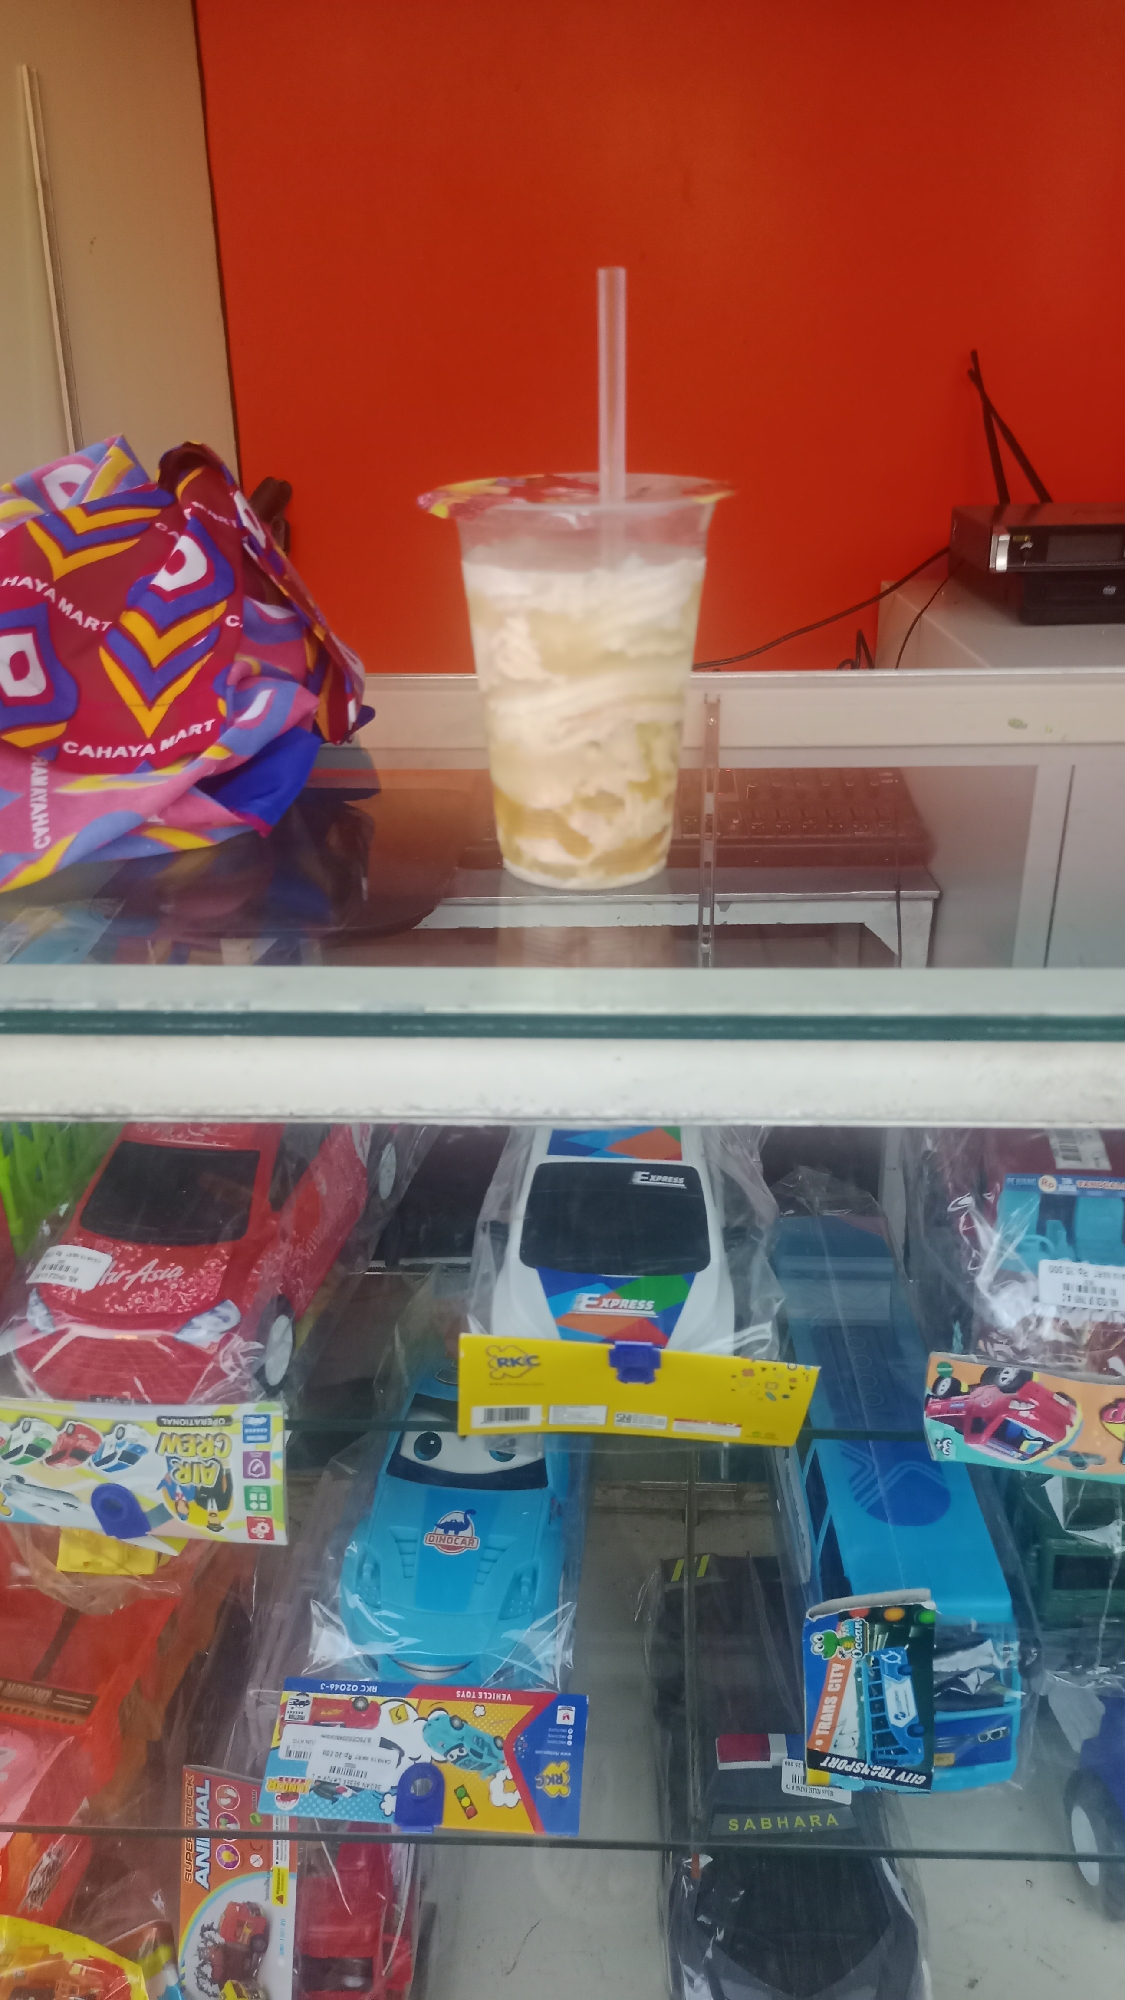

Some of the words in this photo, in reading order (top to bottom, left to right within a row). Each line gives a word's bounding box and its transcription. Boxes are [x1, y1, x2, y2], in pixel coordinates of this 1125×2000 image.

[0, 576, 56, 603] HAYA
[58, 597, 113, 631] MART
[63, 741, 156, 759] CAHAYA
[160, 719, 216, 752] MART
[123, 1258, 184, 1291] Asia
[497, 1355, 540, 1368] RKC
[160, 1417, 226, 1427] OPERATIONAL
[156, 1432, 232, 1459] CREW
[172, 1460, 219, 1487] AIR
[428, 1535, 475, 1547] DINOCAR
[851, 1619, 865, 1659] Ocean
[361, 1685, 378, 1693] RKC
[455, 1690, 476, 1699] TOYS
[478, 1691, 512, 1702] VEHICLE
[816, 1696, 838, 1735] TRANS
[827, 1663, 845, 1693] CITY
[820, 1756, 895, 1780] TRANSPORT
[266, 1778, 313, 1794] JUNIOR
[535, 1773, 564, 1789] RKC
[896, 1773, 927, 1785] CITY
[184, 1774, 195, 1826] TRUCK
[728, 1813, 840, 1832] SABHARA
[195, 1779, 210, 1890] ANIMAL
